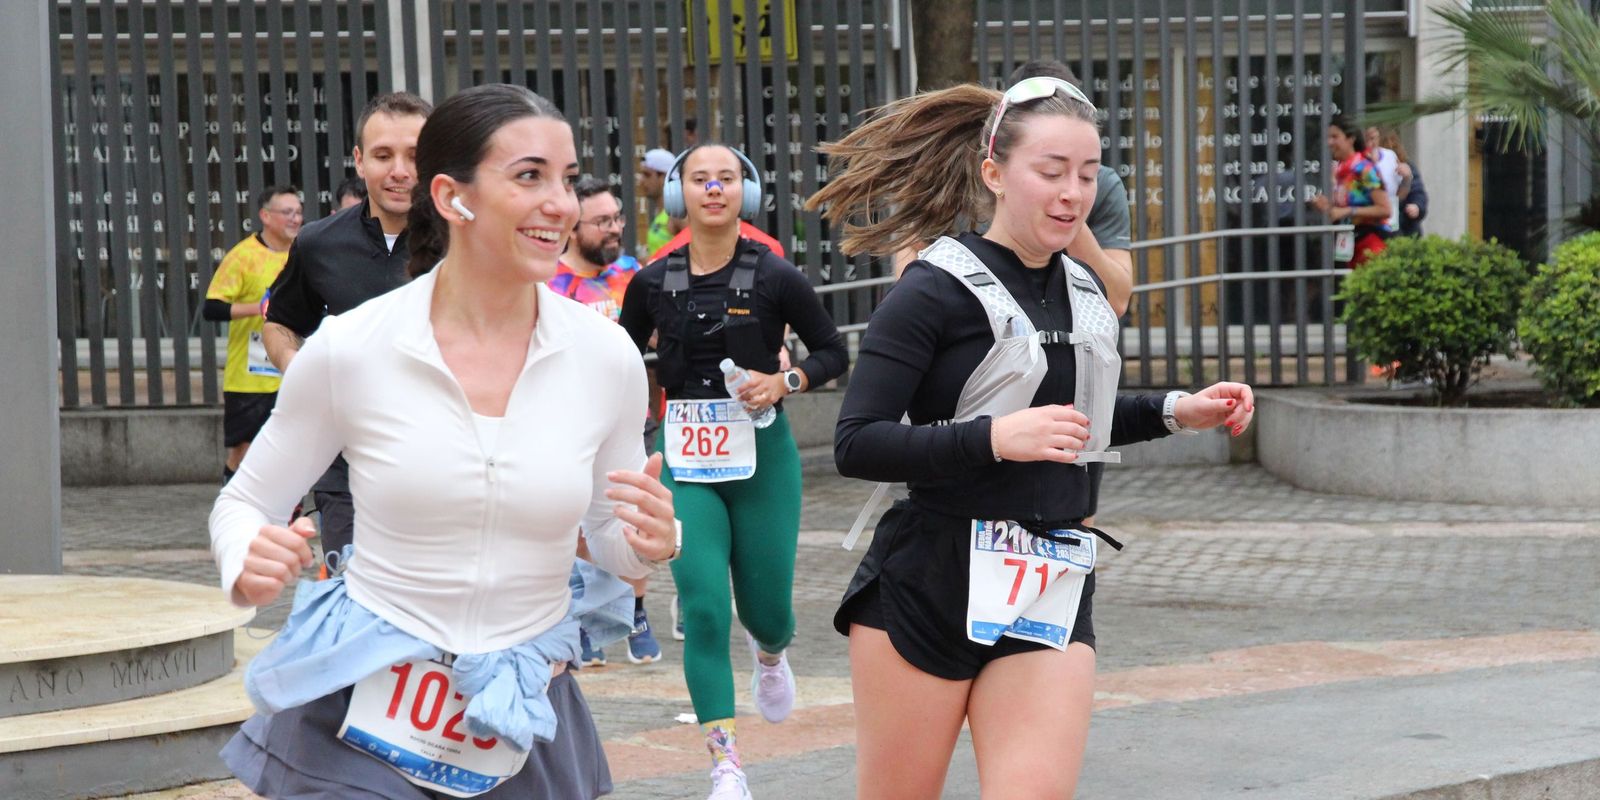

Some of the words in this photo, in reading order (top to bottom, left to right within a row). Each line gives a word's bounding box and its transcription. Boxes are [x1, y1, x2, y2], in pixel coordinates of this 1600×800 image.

[1225, 75, 1260, 94] qe
[1284, 69, 1343, 92] qieo
[1196, 127, 1292, 153] peseuio
[681, 425, 730, 457] 262
[993, 520, 1036, 554] 21K
[109, 647, 197, 689] MMXVII
[385, 661, 498, 751] 102
